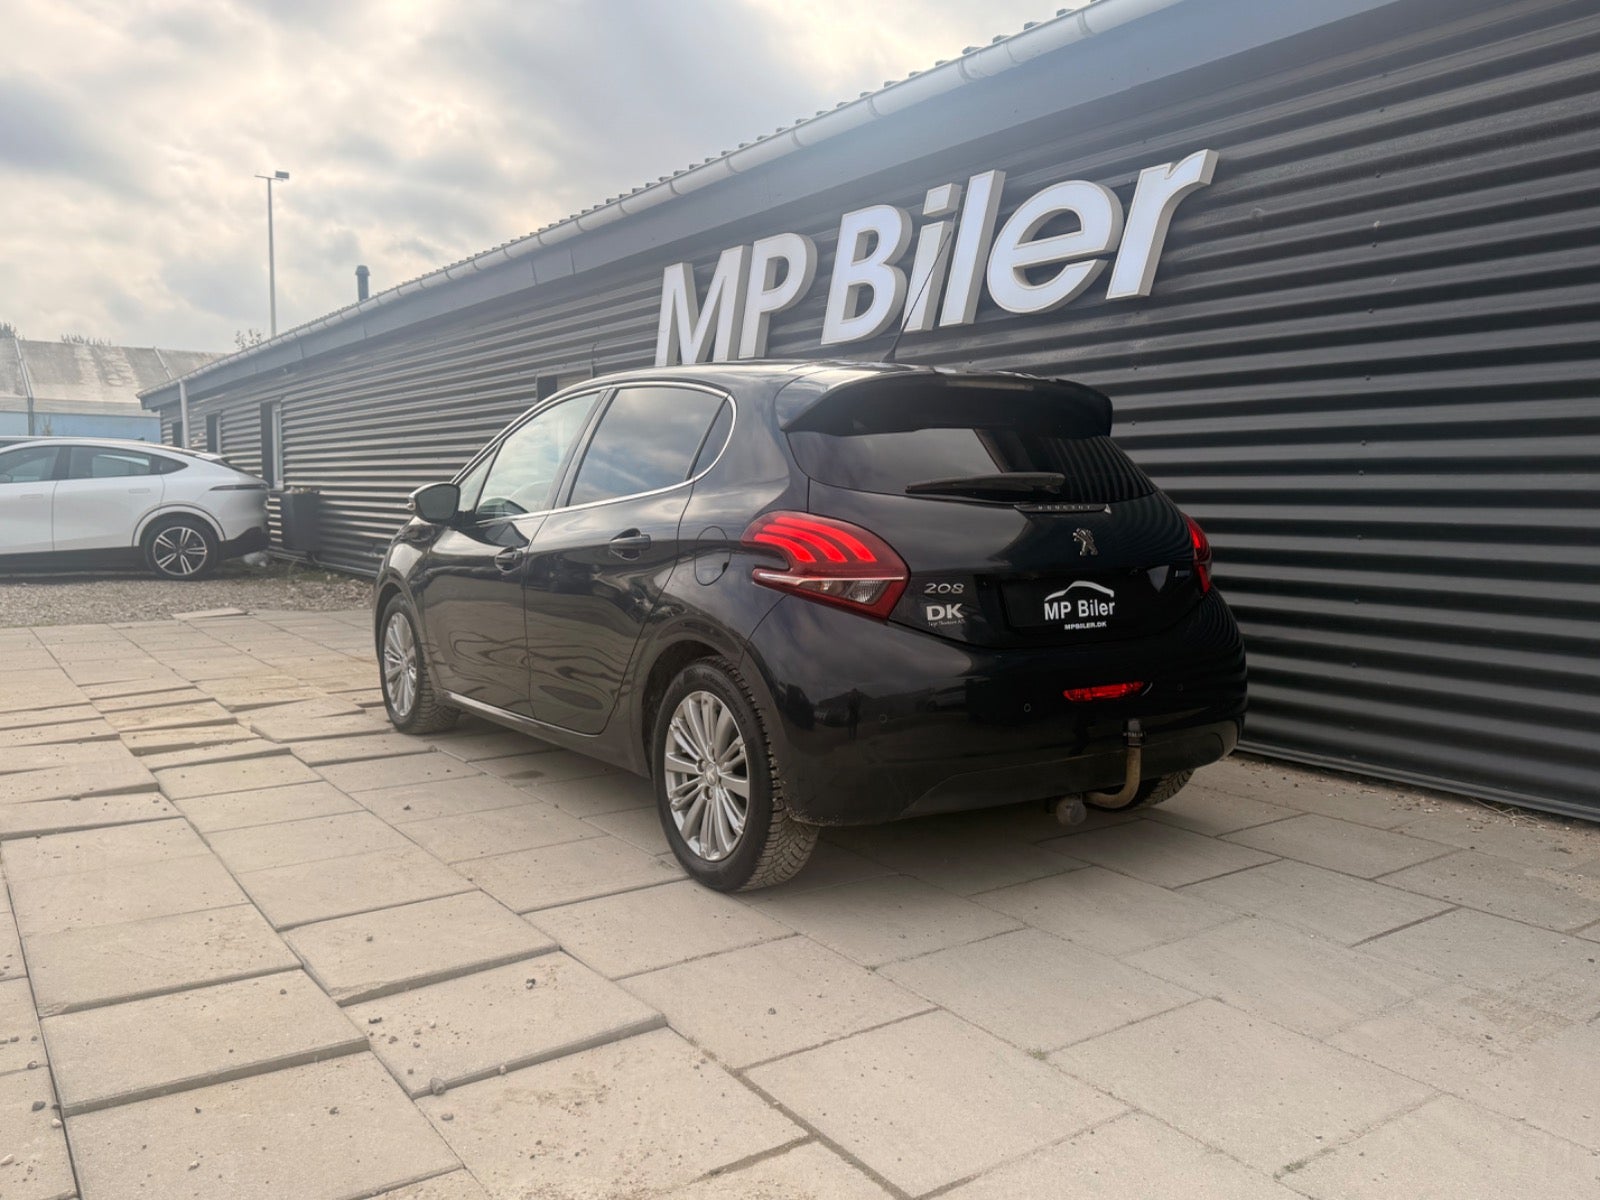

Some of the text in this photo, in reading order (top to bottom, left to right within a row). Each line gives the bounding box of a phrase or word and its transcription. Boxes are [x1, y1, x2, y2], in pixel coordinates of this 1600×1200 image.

[655, 149, 1219, 366] MP Biler
[924, 583, 965, 594] 208
[926, 603, 965, 621] DK
[1044, 599, 1116, 620] MP Biler
